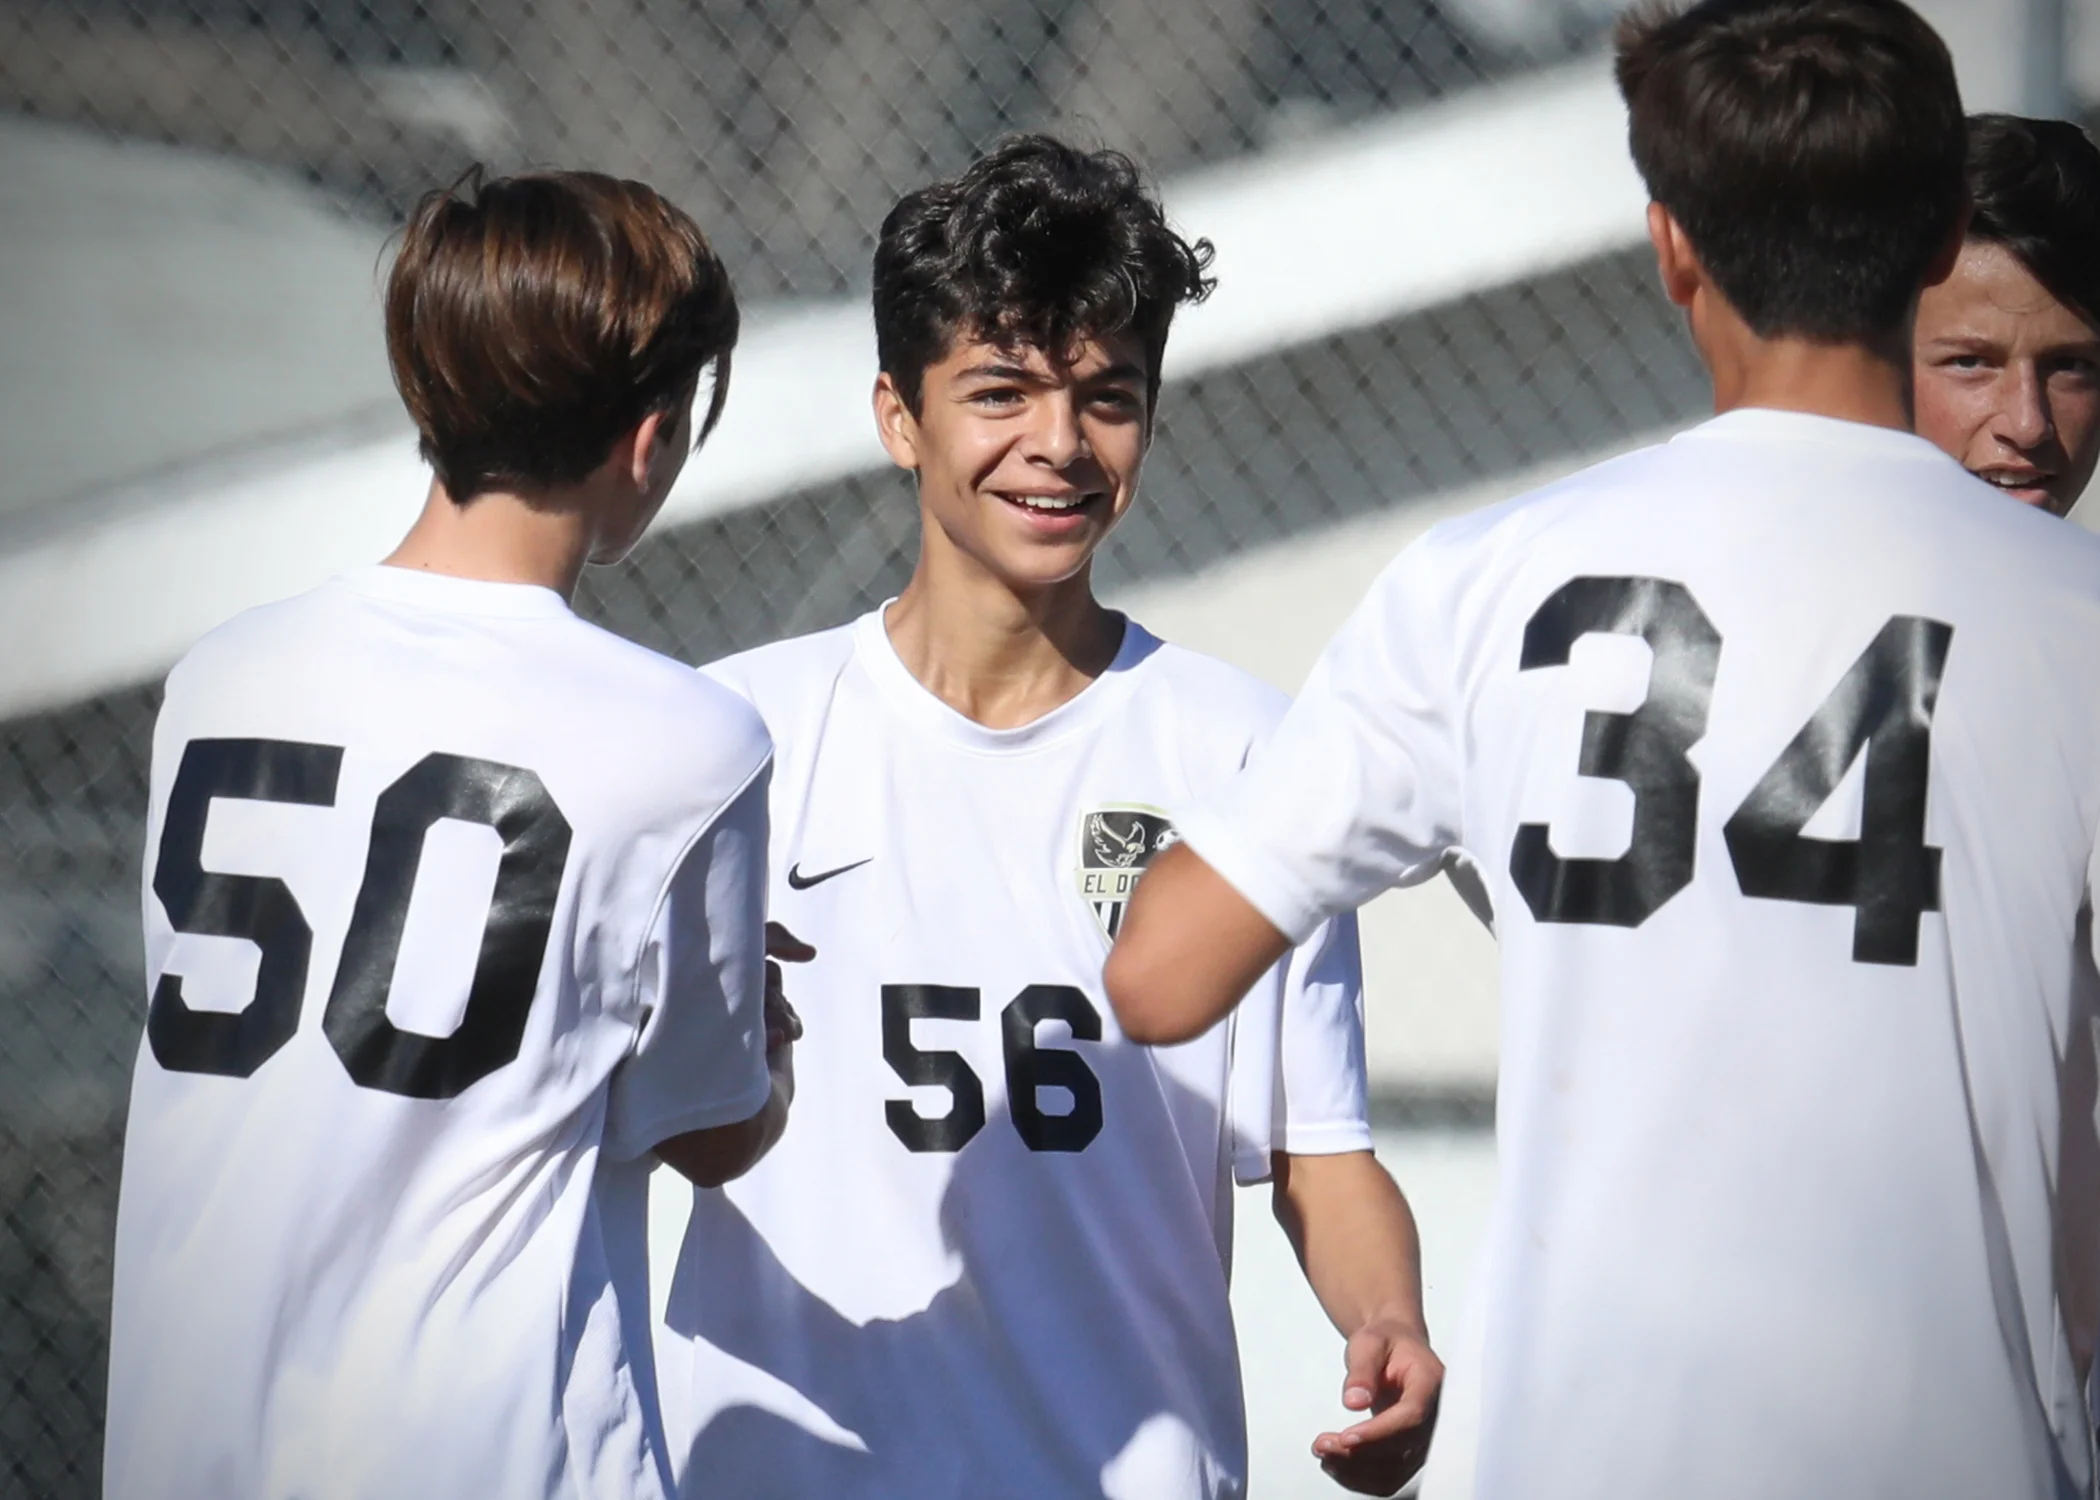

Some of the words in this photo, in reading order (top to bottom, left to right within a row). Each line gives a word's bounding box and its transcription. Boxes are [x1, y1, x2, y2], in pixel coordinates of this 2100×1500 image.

[1084, 874, 1107, 893] EL
[1509, 575, 1954, 966] 34
[147, 737, 572, 1099] 50
[881, 984, 1103, 1153] 56
